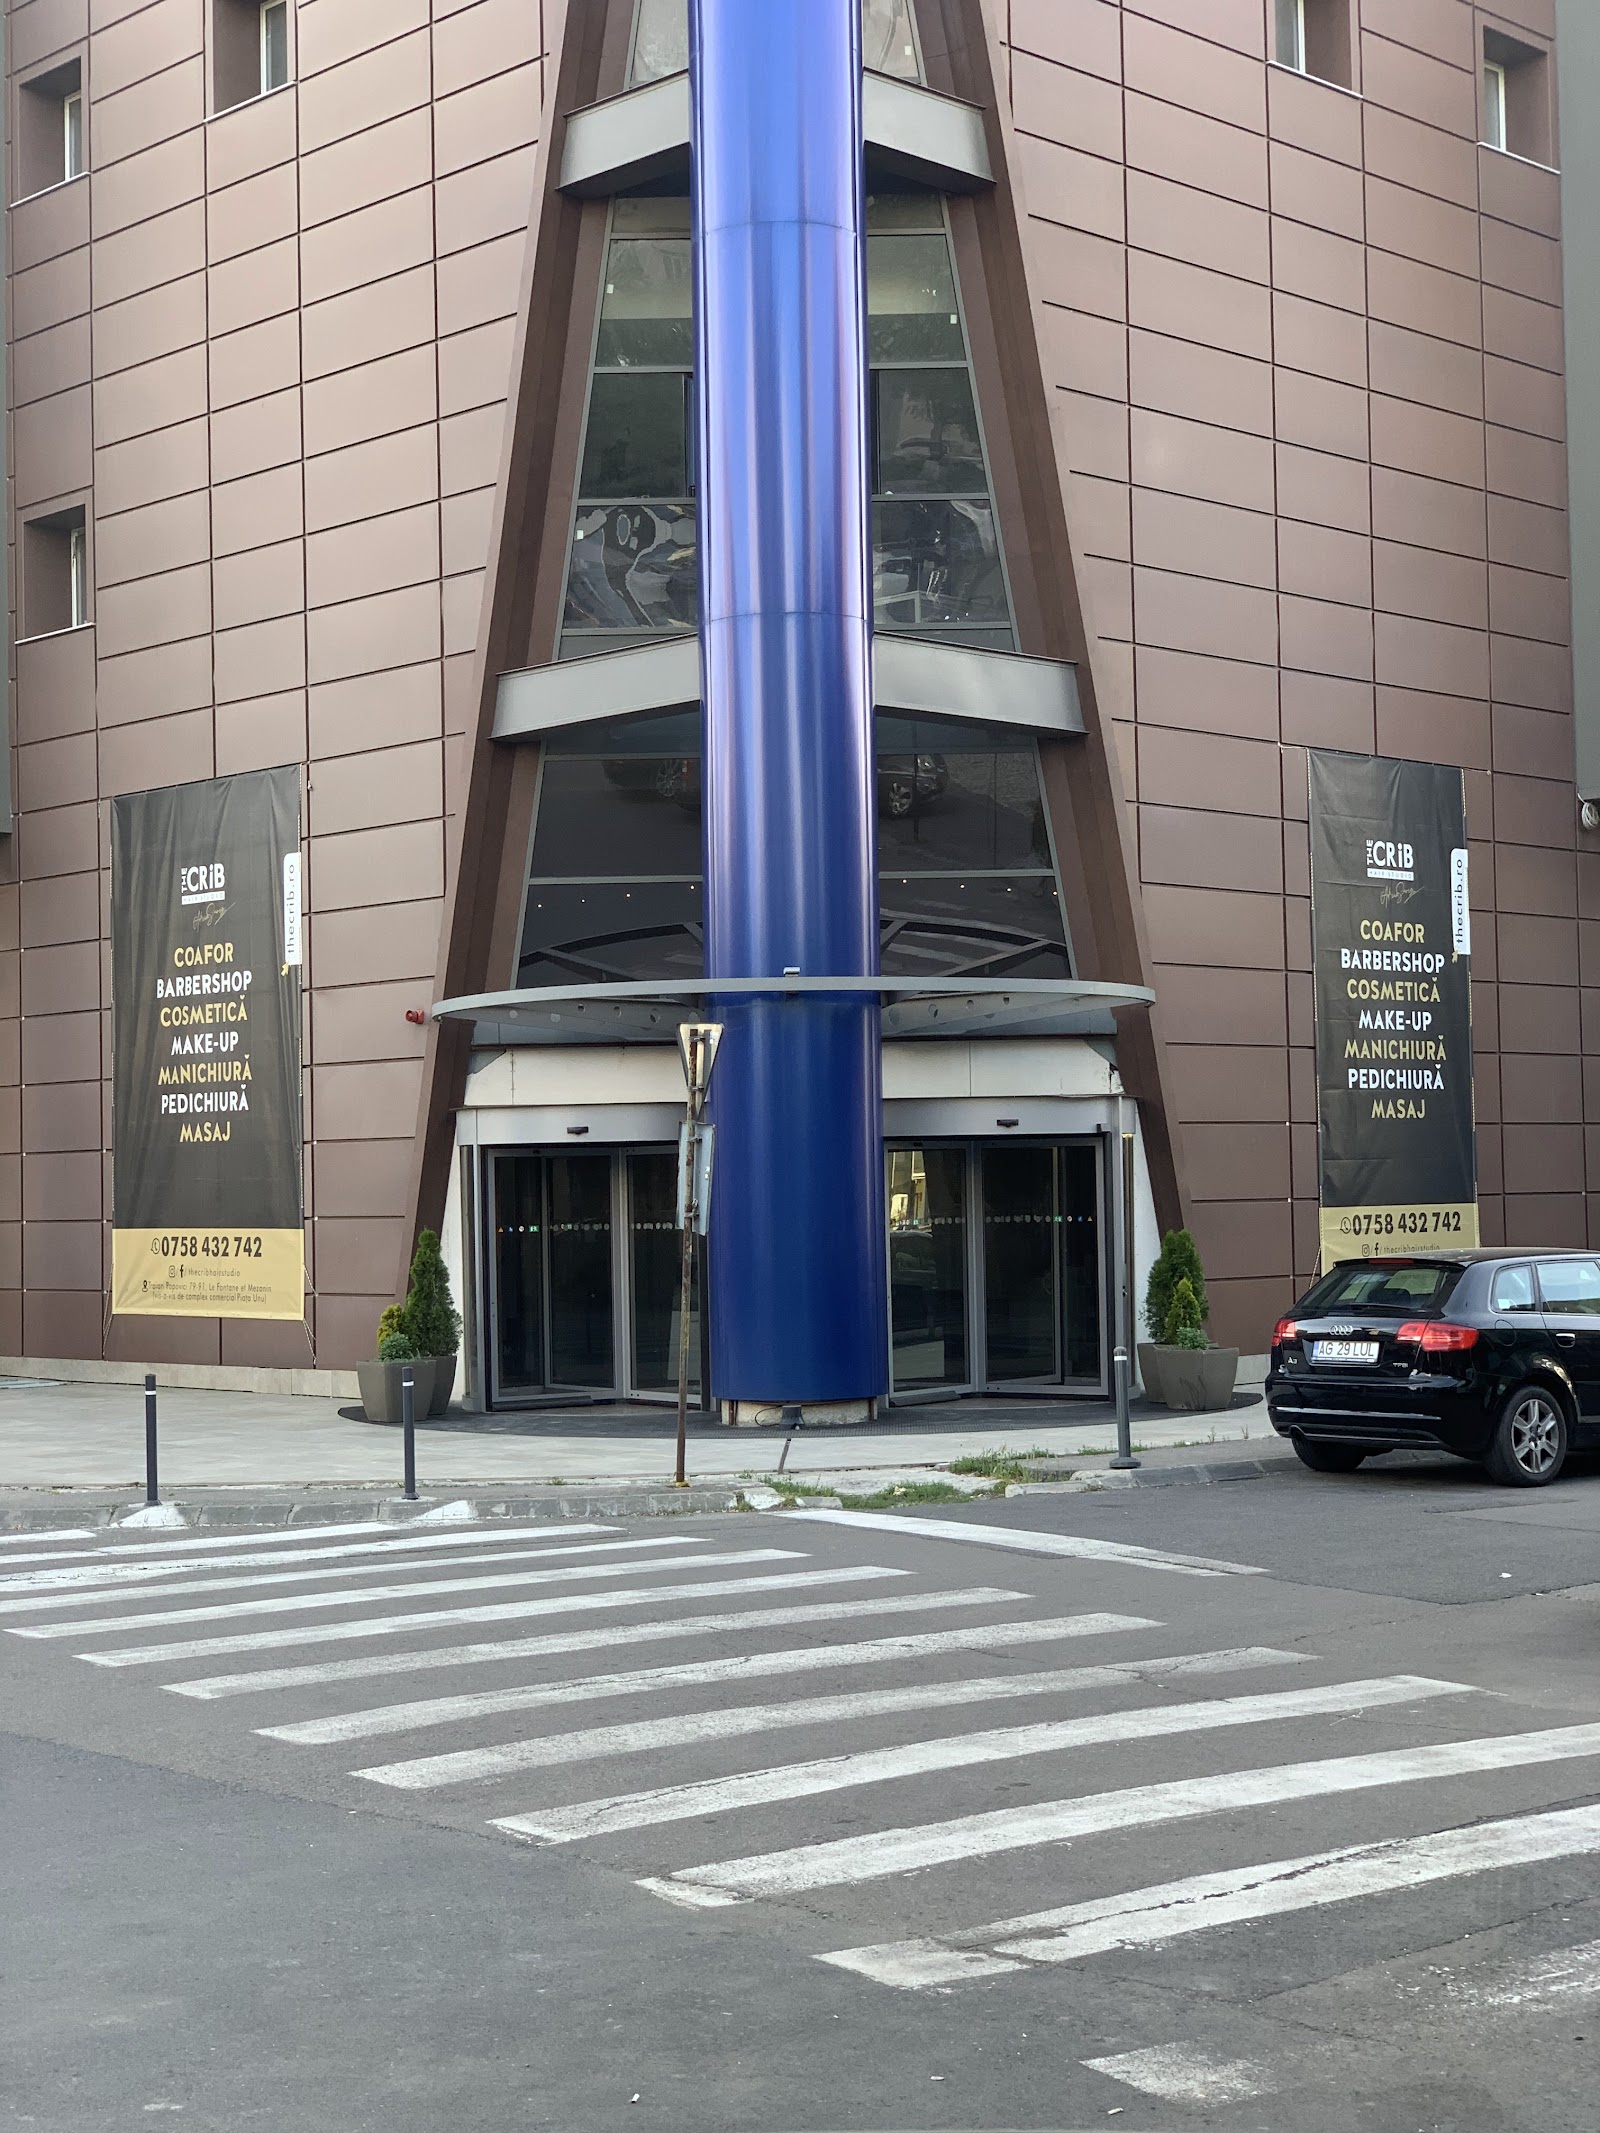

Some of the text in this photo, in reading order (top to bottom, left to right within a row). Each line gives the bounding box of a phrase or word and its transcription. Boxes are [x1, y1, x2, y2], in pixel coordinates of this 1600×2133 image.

[1366, 839, 1374, 866] THE
[286, 864, 295, 953] thecrib.ro
[1454, 859, 1463, 944] thecrib.ro
[1360, 919, 1425, 944] COAFOR
[174, 942, 234, 968] COAFOR
[1340, 948, 1445, 974] BARBERSHOP
[156, 970, 252, 999] BARBERSHOP
[1346, 976, 1441, 1003] COSMETICĂ
[160, 994, 248, 1027] COSMETICĂ
[1358, 1009, 1432, 1031] MAKE-UP
[170, 1031, 239, 1056] MAKE-UP
[1344, 1034, 1447, 1061] MANICHIURĂ
[158, 1053, 252, 1086] MANICHIURĂ
[1348, 1063, 1445, 1090] PEDICHIURĂ
[161, 1083, 249, 1115] PEDICHIURĂ
[1371, 1098, 1426, 1119] MASAJ
[179, 1121, 231, 1143] MASAJ
[1352, 1211, 1461, 1236] 0758 432 742
[161, 1236, 262, 1258] 0758 432 742
[1287, 1356, 1298, 1364] A3
[1318, 1341, 1374, 1357] AG 29 LUL
